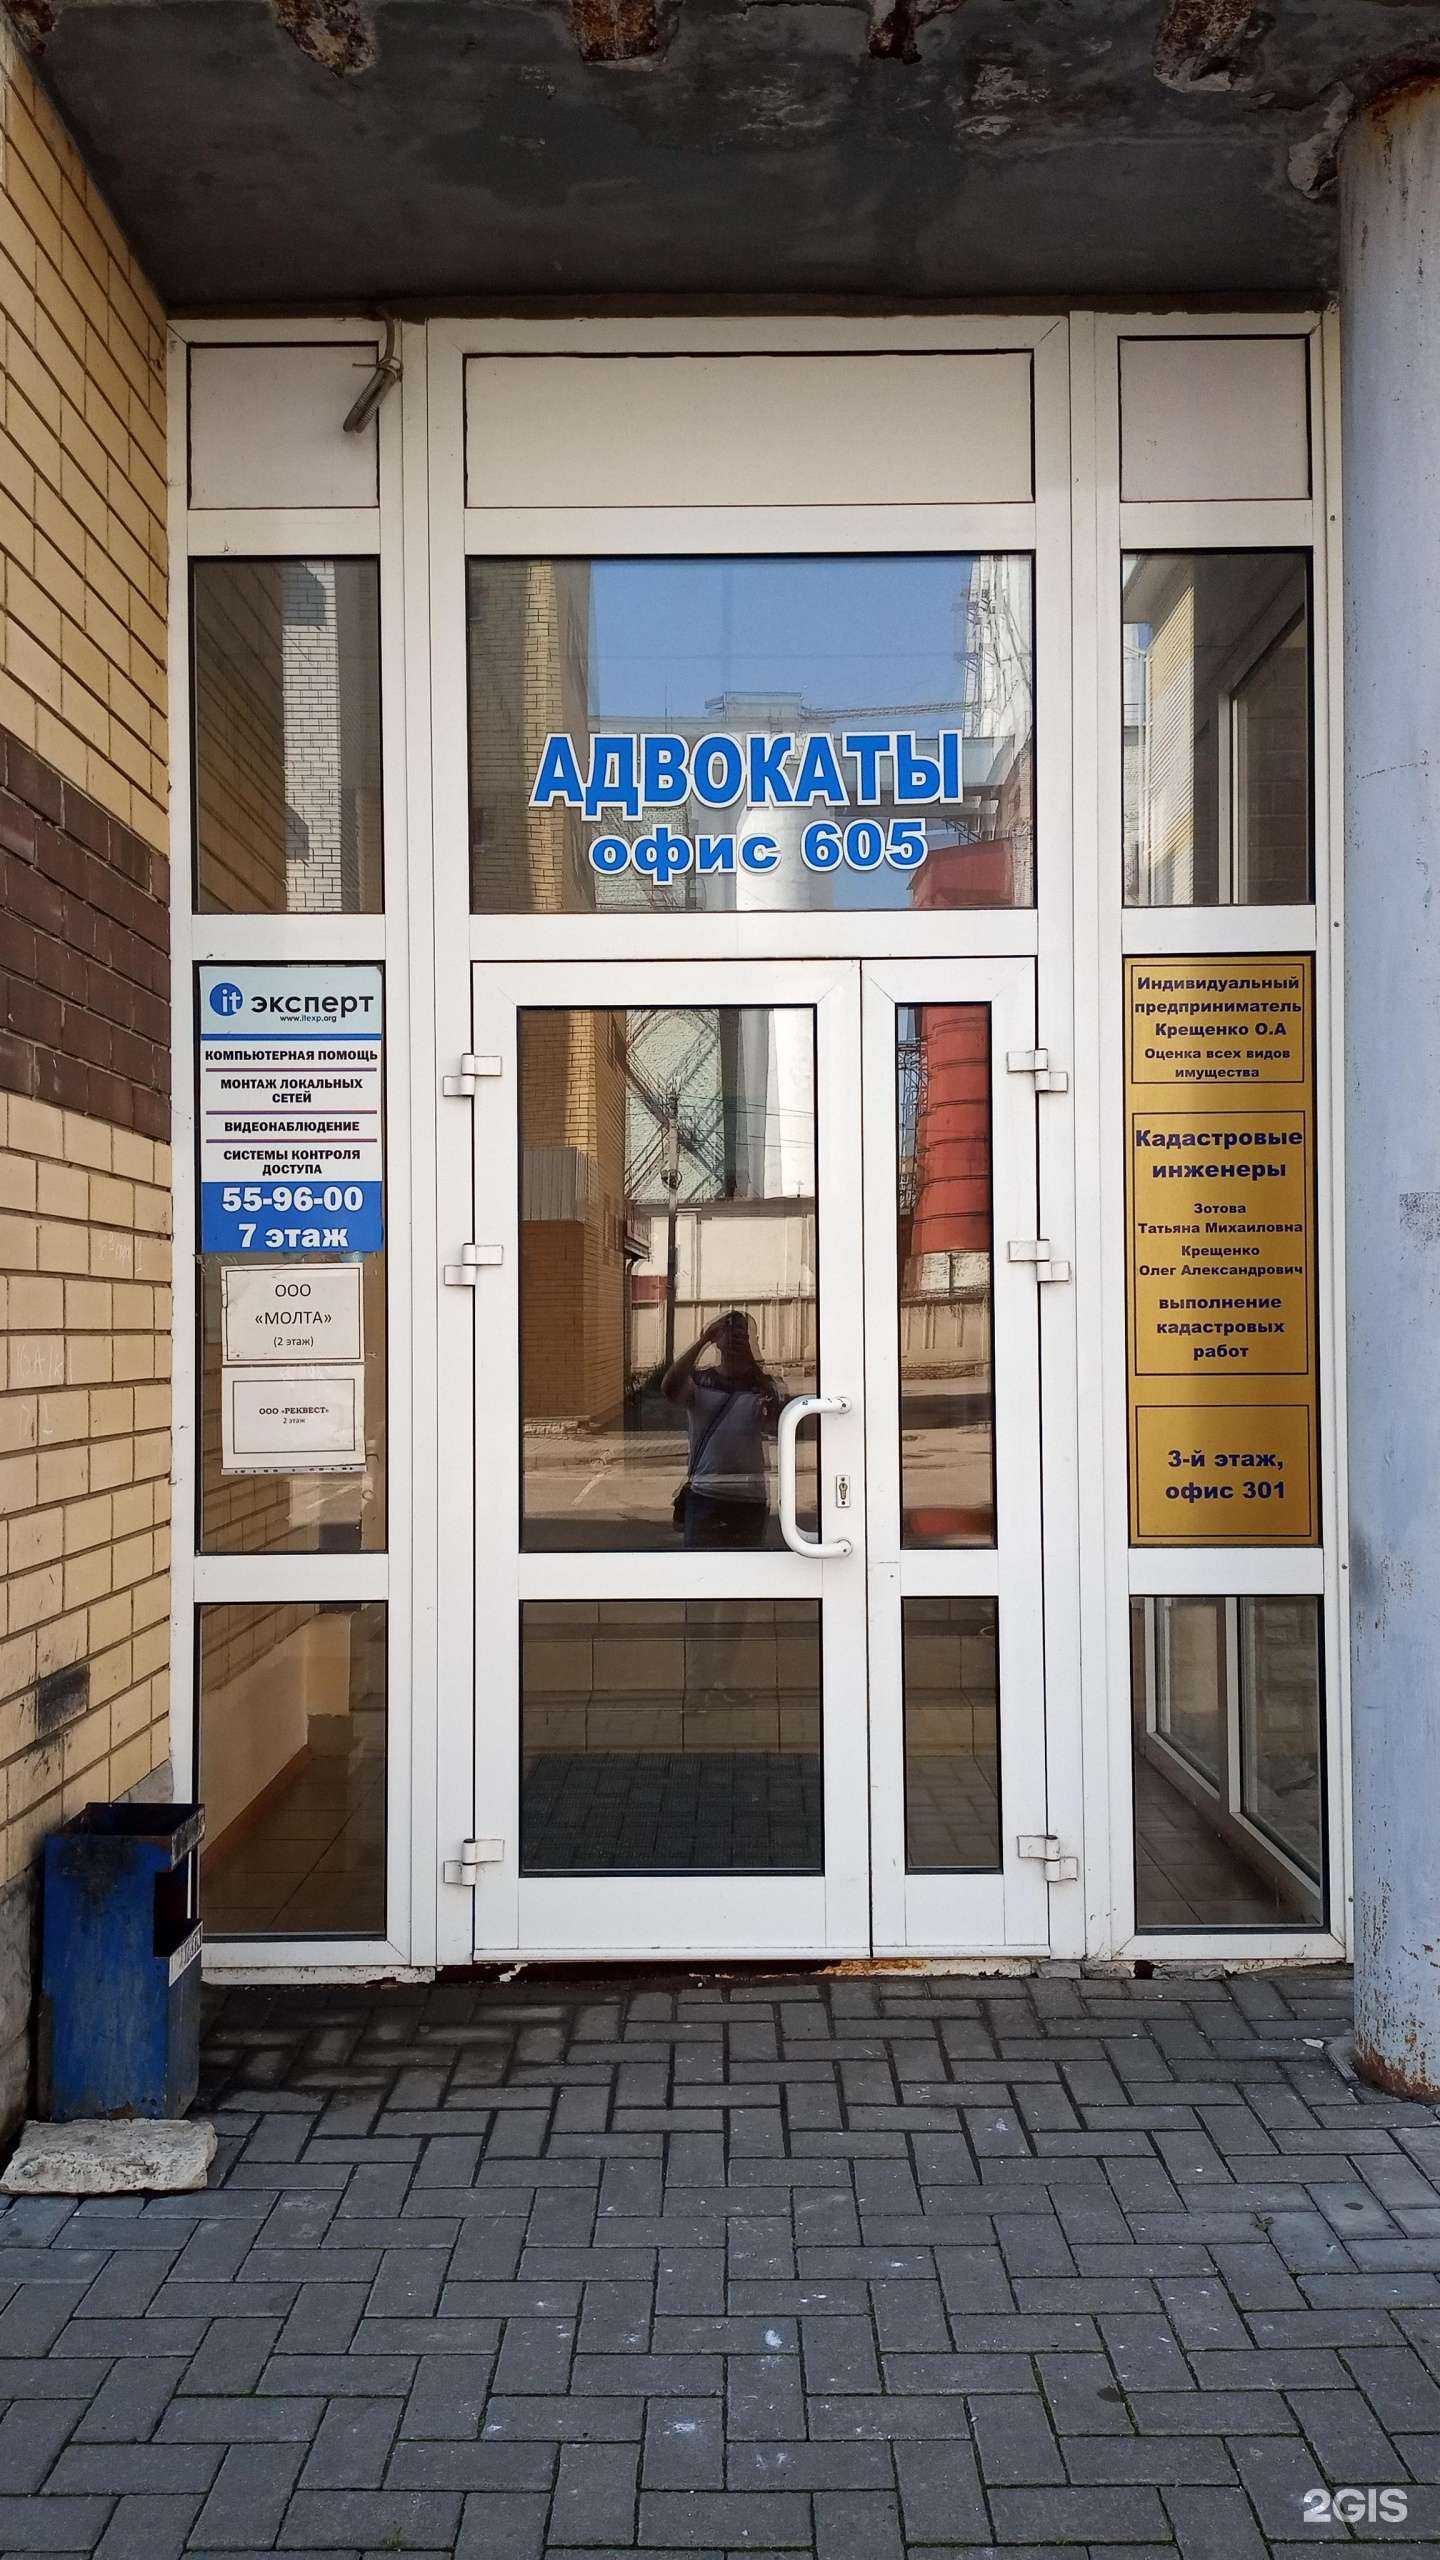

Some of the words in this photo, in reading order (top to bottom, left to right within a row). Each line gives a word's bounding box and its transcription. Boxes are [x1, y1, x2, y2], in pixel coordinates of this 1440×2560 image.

[529, 729, 963, 821] АДВОКАТЫ
[589, 823, 781, 886] офис
[800, 818, 928, 872] 605
[1137, 975, 1300, 991] Индивидуальный
[221, 989, 242, 1013] it
[251, 995, 375, 1017] эксперт
[1134, 1000, 1302, 1016] предприниматель
[1155, 1023, 1249, 1039] Крещенко
[1254, 1023, 1287, 1036] О.А
[205, 1050, 315, 1062] КОМПЬЮТЕРНАЯ
[318, 1050, 378, 1062] ПОМОЩЬ
[1144, 1048, 1201, 1060] Оценка
[1206, 1049, 1241, 1059] всех
[1246, 1049, 1290, 1060] видов
[1175, 1068, 1260, 1080] имущества
[220, 1079, 277, 1090] МОНТАЖ
[280, 1079, 363, 1090] ЛОКАЛЬНЫХ
[272, 1090, 312, 1103] СЕТЕЙ
[224, 1121, 360, 1133] ВИДЕОНАБЛЮДЕНИЕ
[1136, 1130, 1303, 1150] Кадастровые
[223, 1150, 289, 1161] СИСТЕМЫ
[291, 1150, 361, 1161] КОНТРОЛЯ
[262, 1165, 322, 1176] ДОСТУПА
[1152, 1162, 1286, 1180] инженеры
[222, 1186, 364, 1213] 55-96-00
[1193, 1203, 1246, 1214] Зотова
[238, 1223, 257, 1248] 7
[264, 1227, 349, 1248] этаж
[1138, 1223, 1200, 1234] Татьяна
[1181, 1245, 1260, 1259] Крещенко
[1139, 1265, 1176, 1276] Олег
[1181, 1264, 1303, 1278] Александрович
[275, 1284, 311, 1297] ООО
[1159, 1297, 1282, 1309] выполнение
[255, 1311, 332, 1325] «МОЛТА»
[1157, 1321, 1285, 1336] кадастровых
[273, 1337, 283, 1347] (2
[285, 1337, 314, 1347] этаж)
[1193, 1344, 1249, 1360] работ
[1168, 1450, 1205, 1467] 3-й
[1215, 1452, 1283, 1470] этаж,
[1166, 1482, 1233, 1503] офис
[1243, 1481, 1285, 1498] 301
